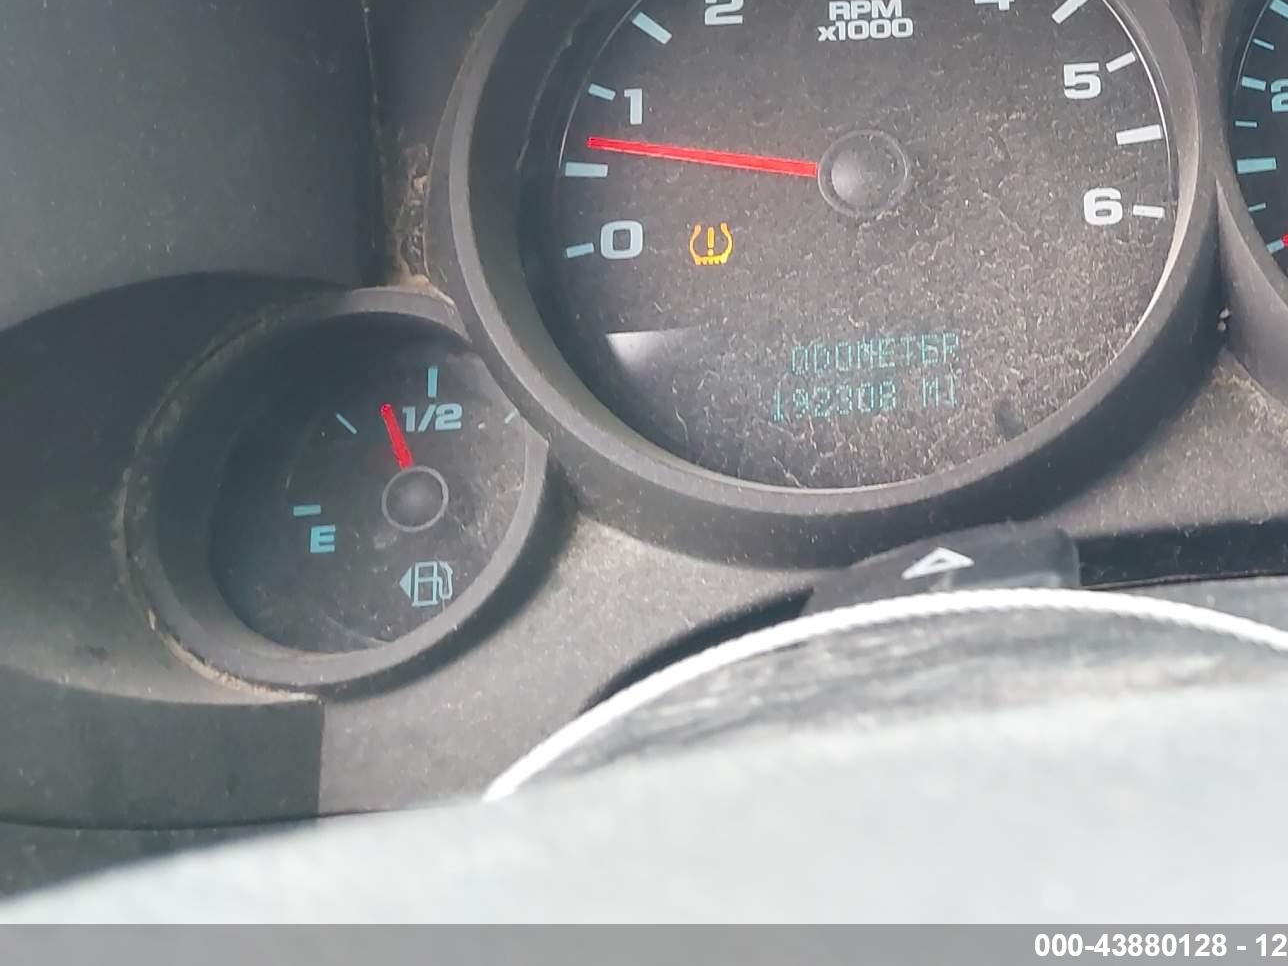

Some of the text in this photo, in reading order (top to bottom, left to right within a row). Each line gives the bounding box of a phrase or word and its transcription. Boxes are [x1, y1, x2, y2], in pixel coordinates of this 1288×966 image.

[817, 17, 913, 42] x1000
[1063, 62, 1101, 101] 5
[623, 88, 643, 125] 1
[1082, 187, 1124, 226] 6
[599, 220, 643, 260] 0
[791, 331, 959, 375] ODOMETER
[403, 403, 462, 432] 1/2
[310, 525, 336, 553] E
